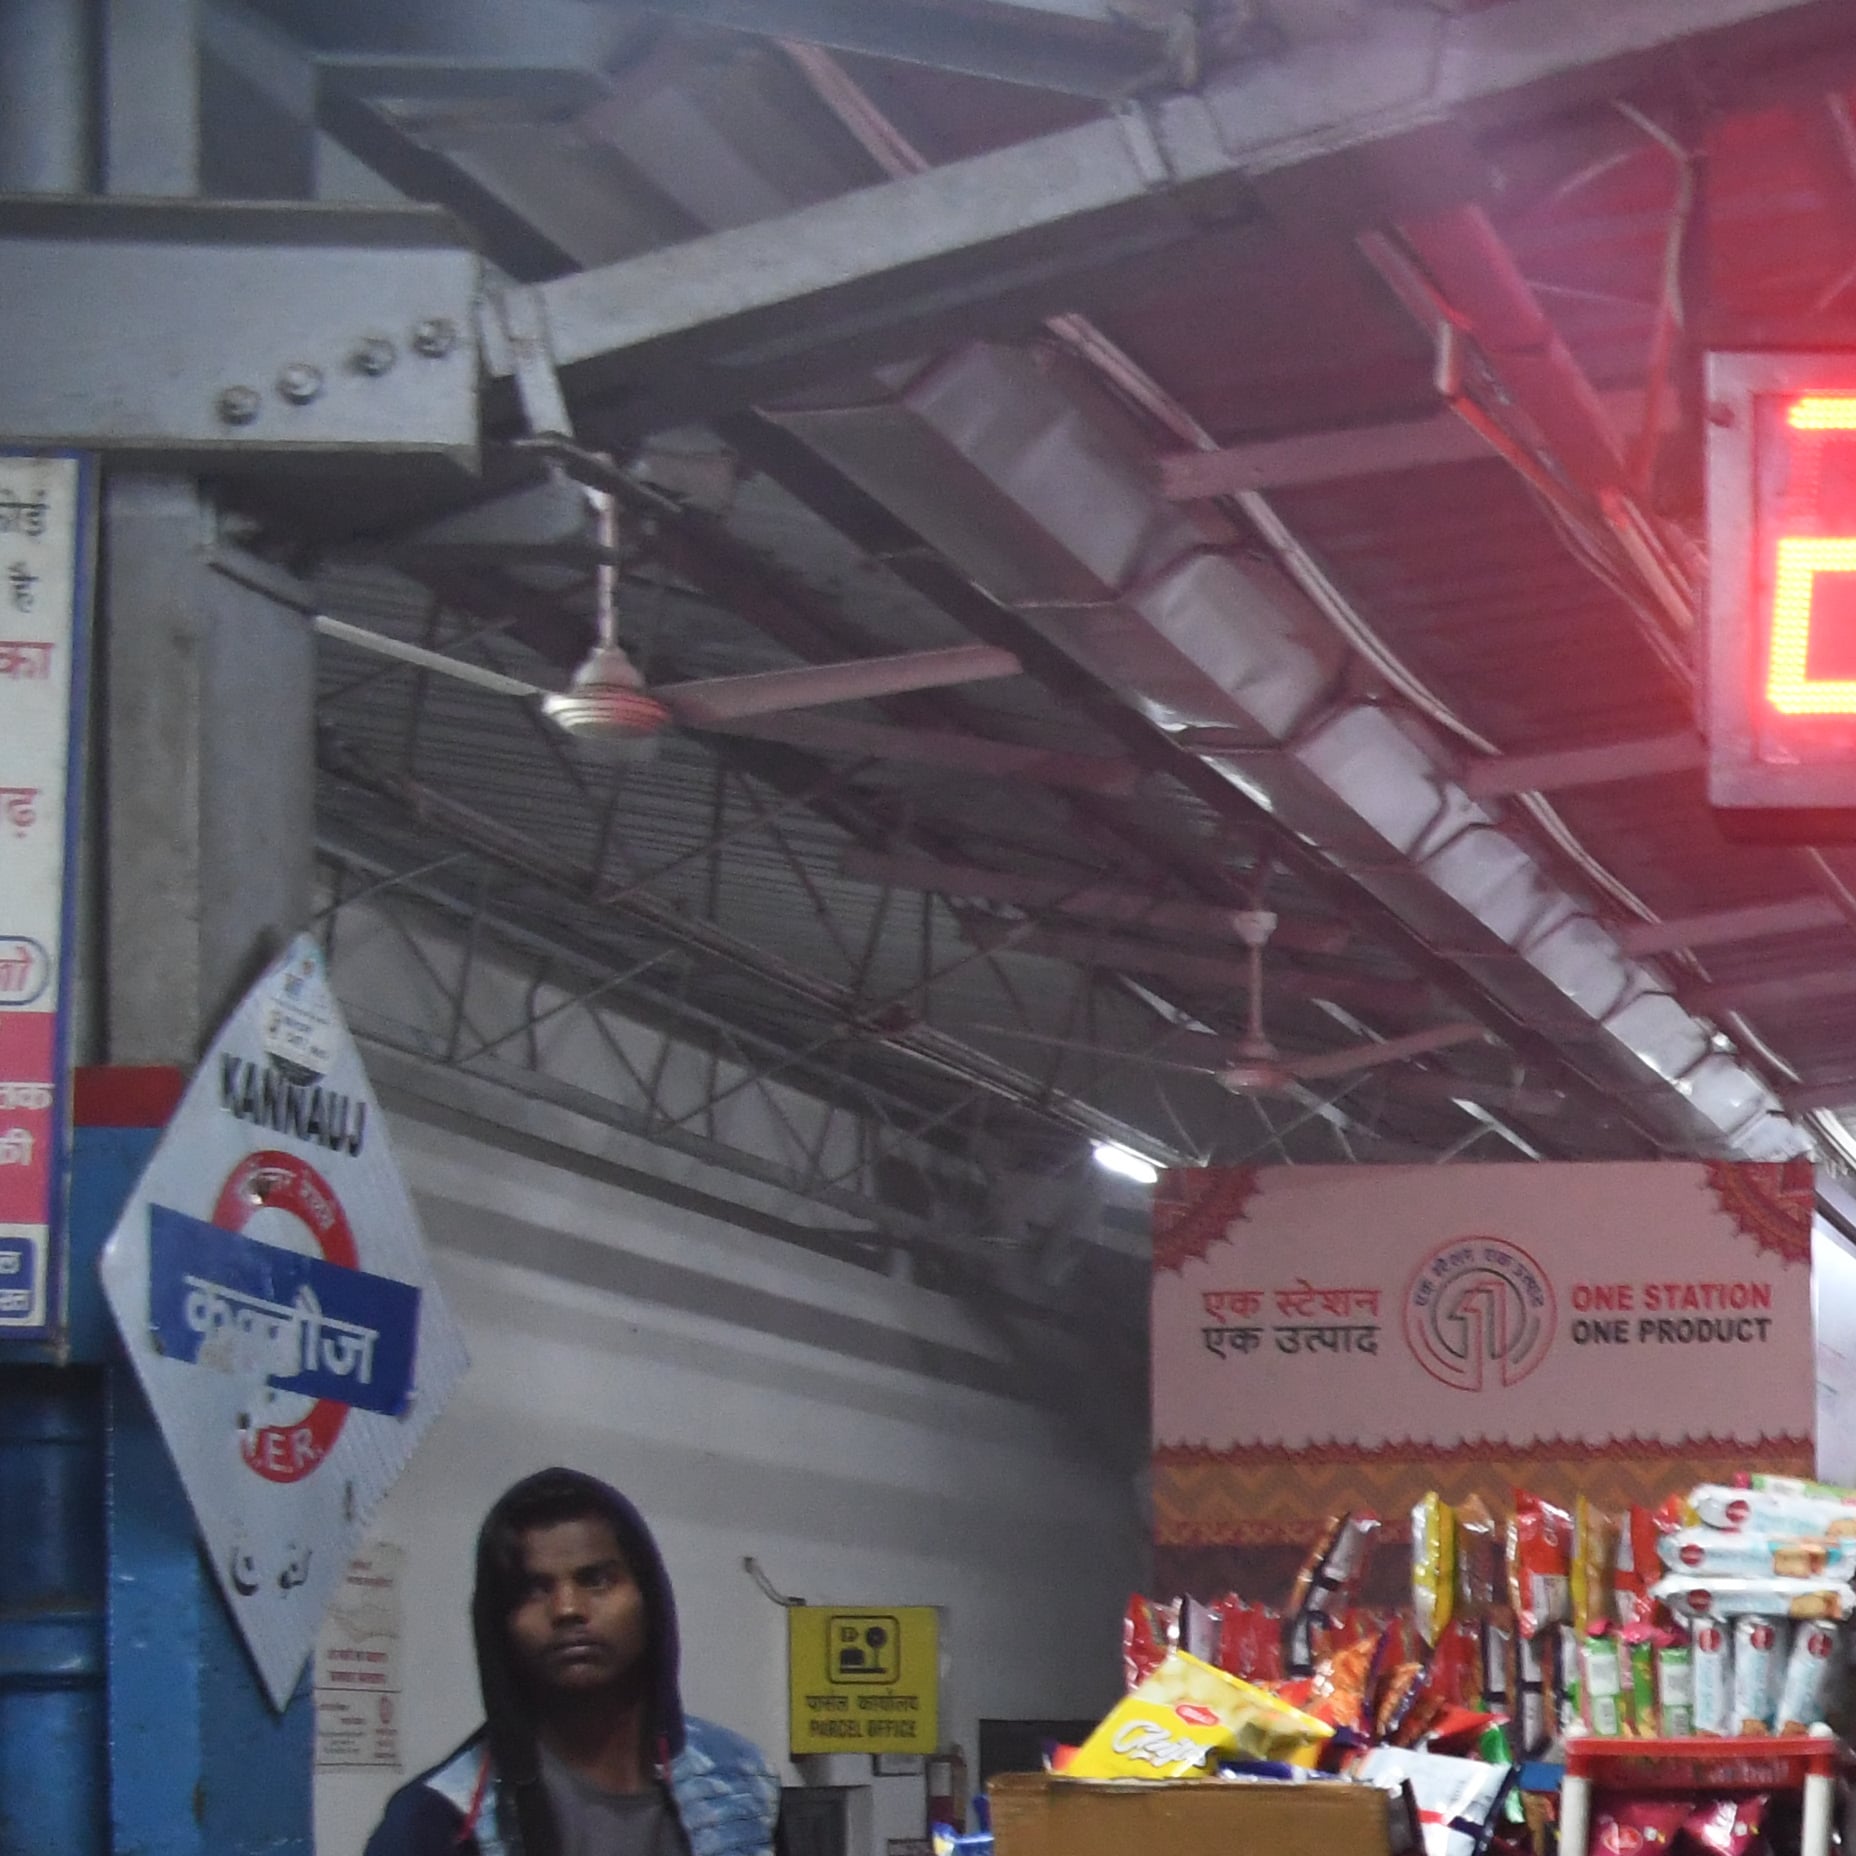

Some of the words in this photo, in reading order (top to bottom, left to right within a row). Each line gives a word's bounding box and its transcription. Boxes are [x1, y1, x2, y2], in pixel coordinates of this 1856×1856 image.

[220, 1052, 367, 1158] KANNAUJ
[1202, 1290, 1265, 1325] एक
[1273, 1276, 1383, 1319] स्टेशन
[1571, 1284, 1635, 1312] ONE
[1643, 1282, 1773, 1312] STATION
[1202, 1327, 1265, 1361] एक
[1272, 1324, 1382, 1357] उत्पाद
[1571, 1318, 1631, 1345] ONE
[1638, 1316, 1773, 1345] PRODUCT
[810, 1719, 863, 1738] PARCEL
[868, 1719, 917, 1738] OFFICE
